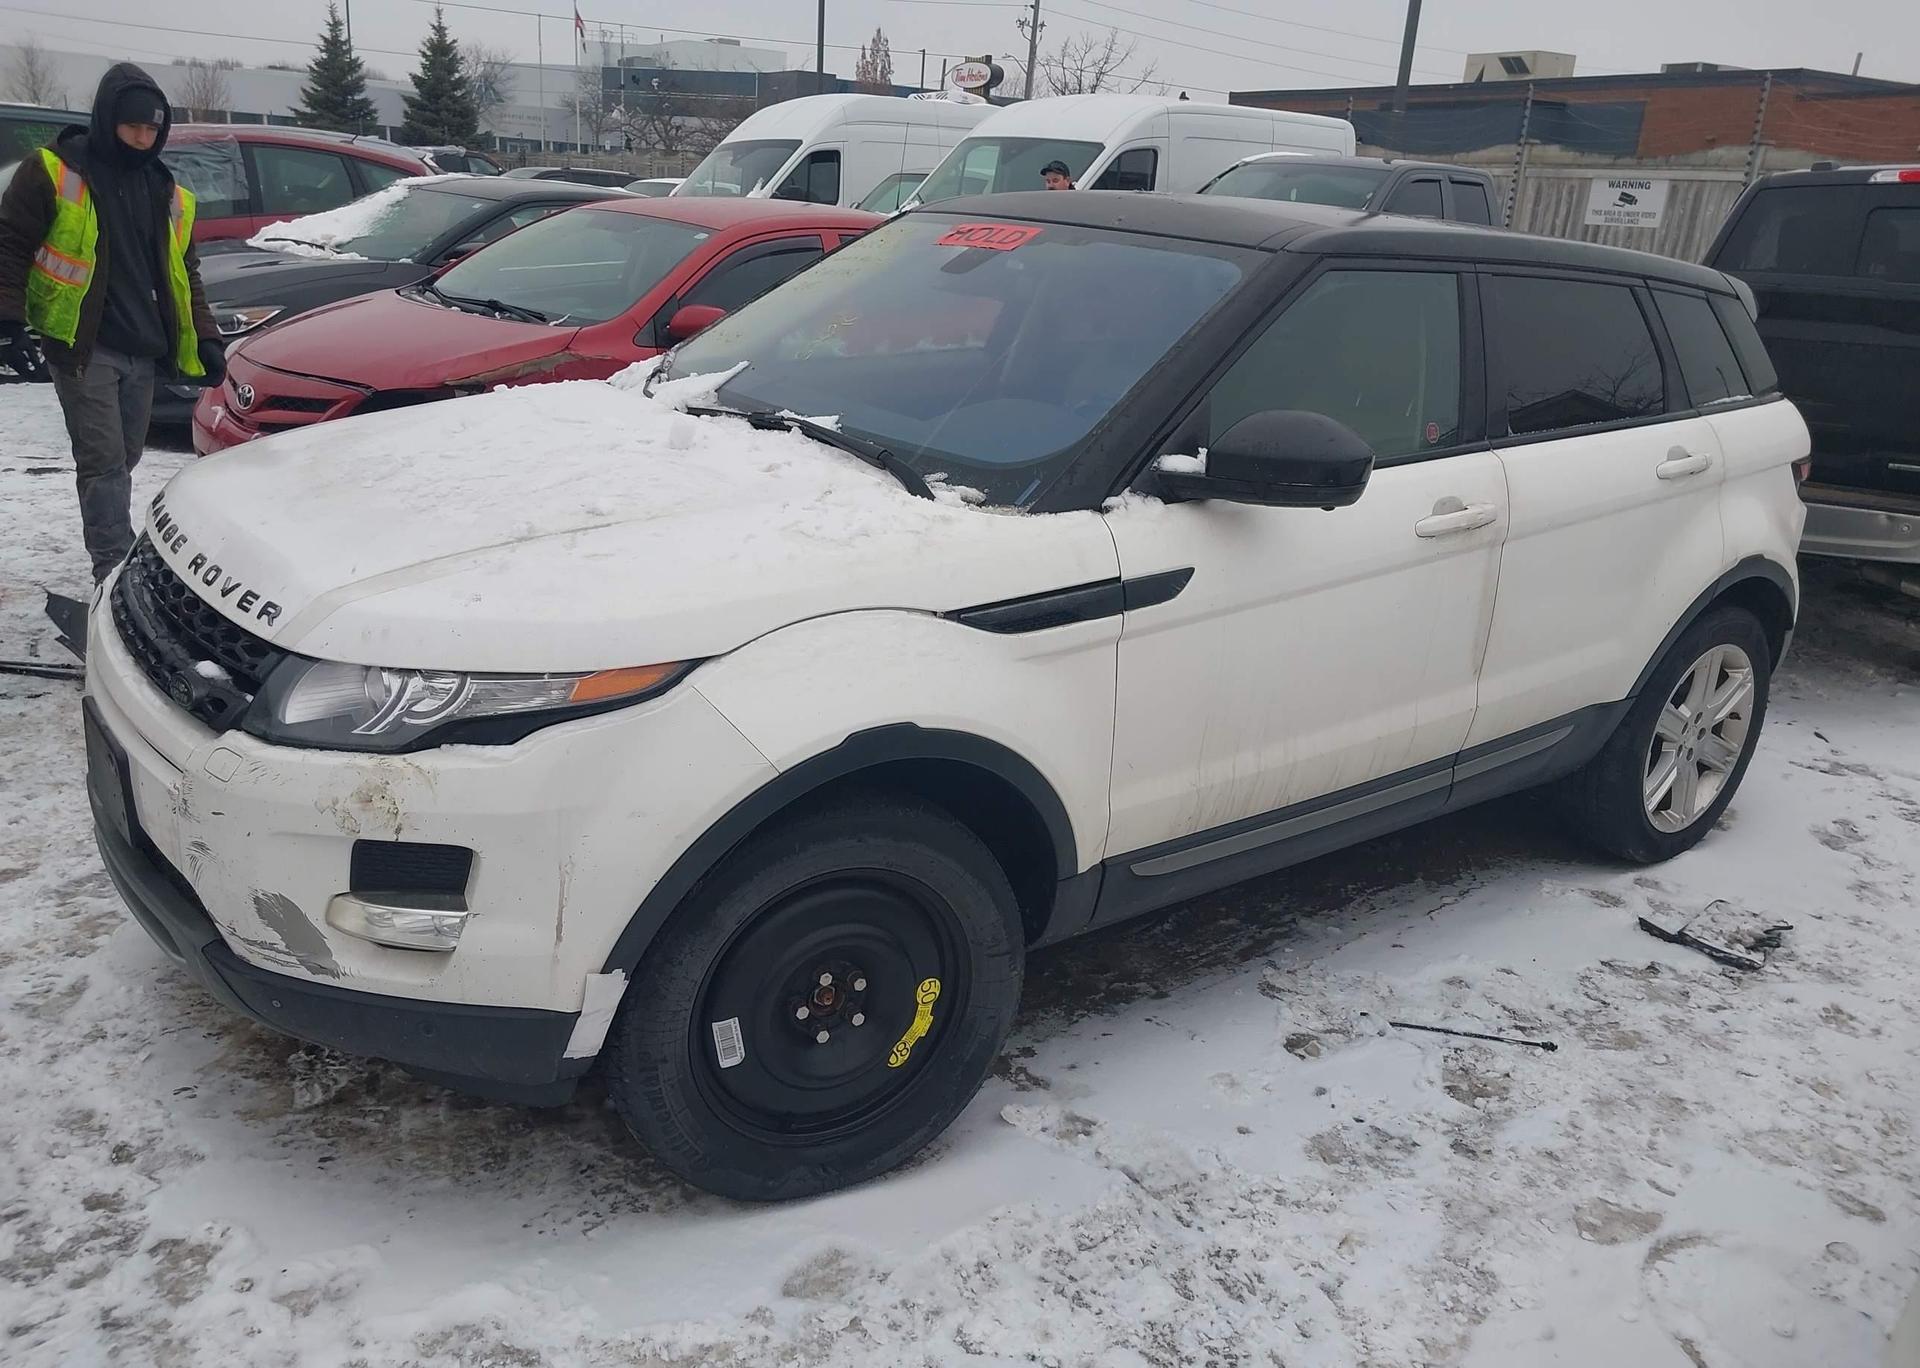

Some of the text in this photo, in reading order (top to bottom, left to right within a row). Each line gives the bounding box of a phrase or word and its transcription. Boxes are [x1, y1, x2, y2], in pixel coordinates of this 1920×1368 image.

[1608, 180, 1652, 190] WARNING
[1603, 209, 1616, 217] AREA
[944, 226, 1028, 245] HOLD
[187, 552, 283, 627] ROVER
[920, 980, 937, 1005] 50
[887, 1041, 910, 1066] 80
